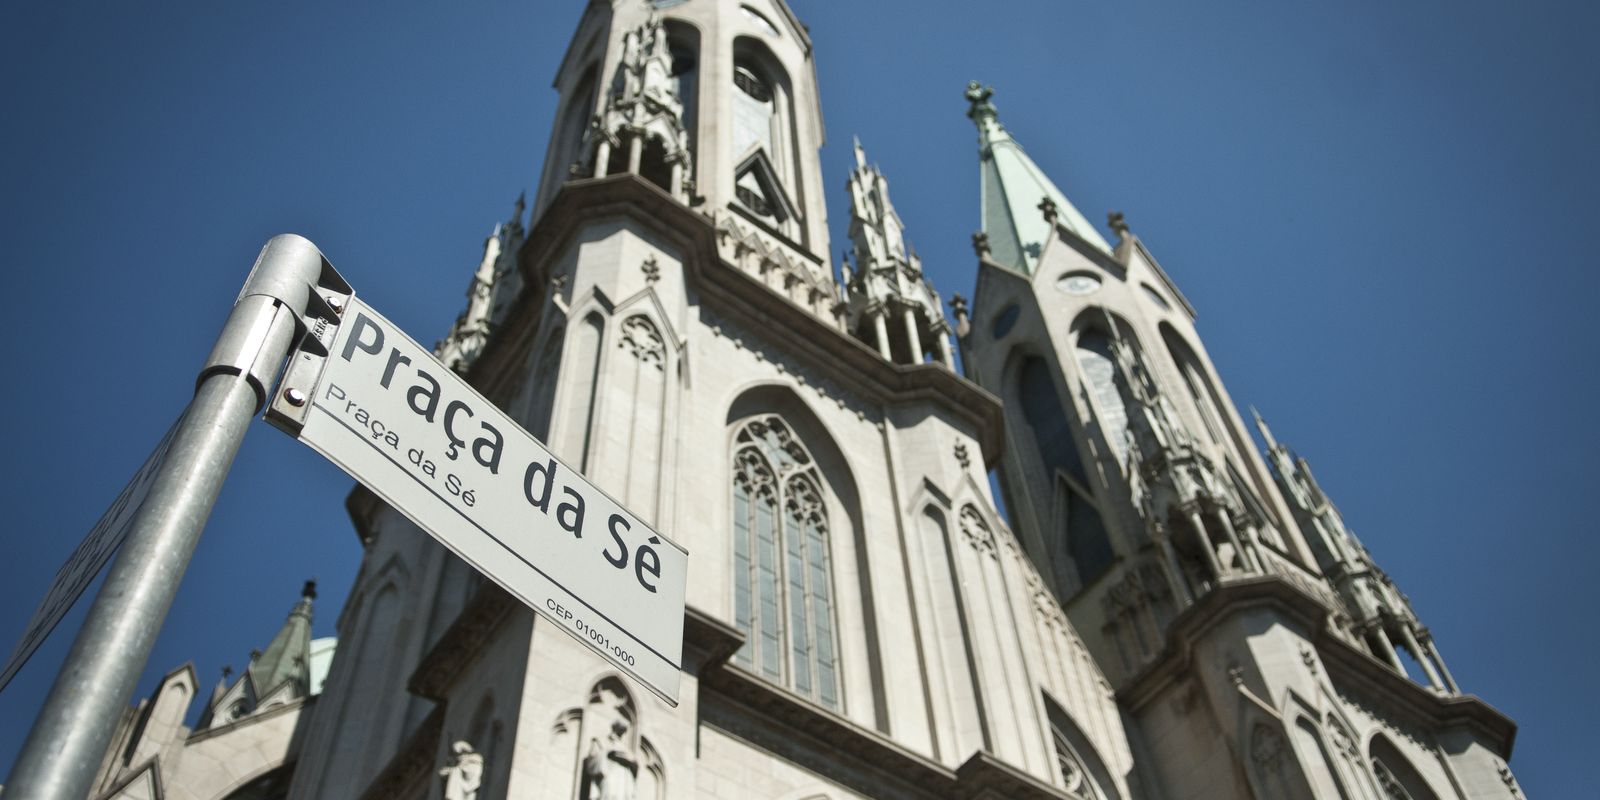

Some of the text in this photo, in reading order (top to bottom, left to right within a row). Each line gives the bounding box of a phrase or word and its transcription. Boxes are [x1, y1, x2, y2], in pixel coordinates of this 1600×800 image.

[326, 384, 476, 507] Praça da Sé
[341, 312, 662, 594] Praça da Sé
[546, 598, 635, 667] CEP 01001-000
